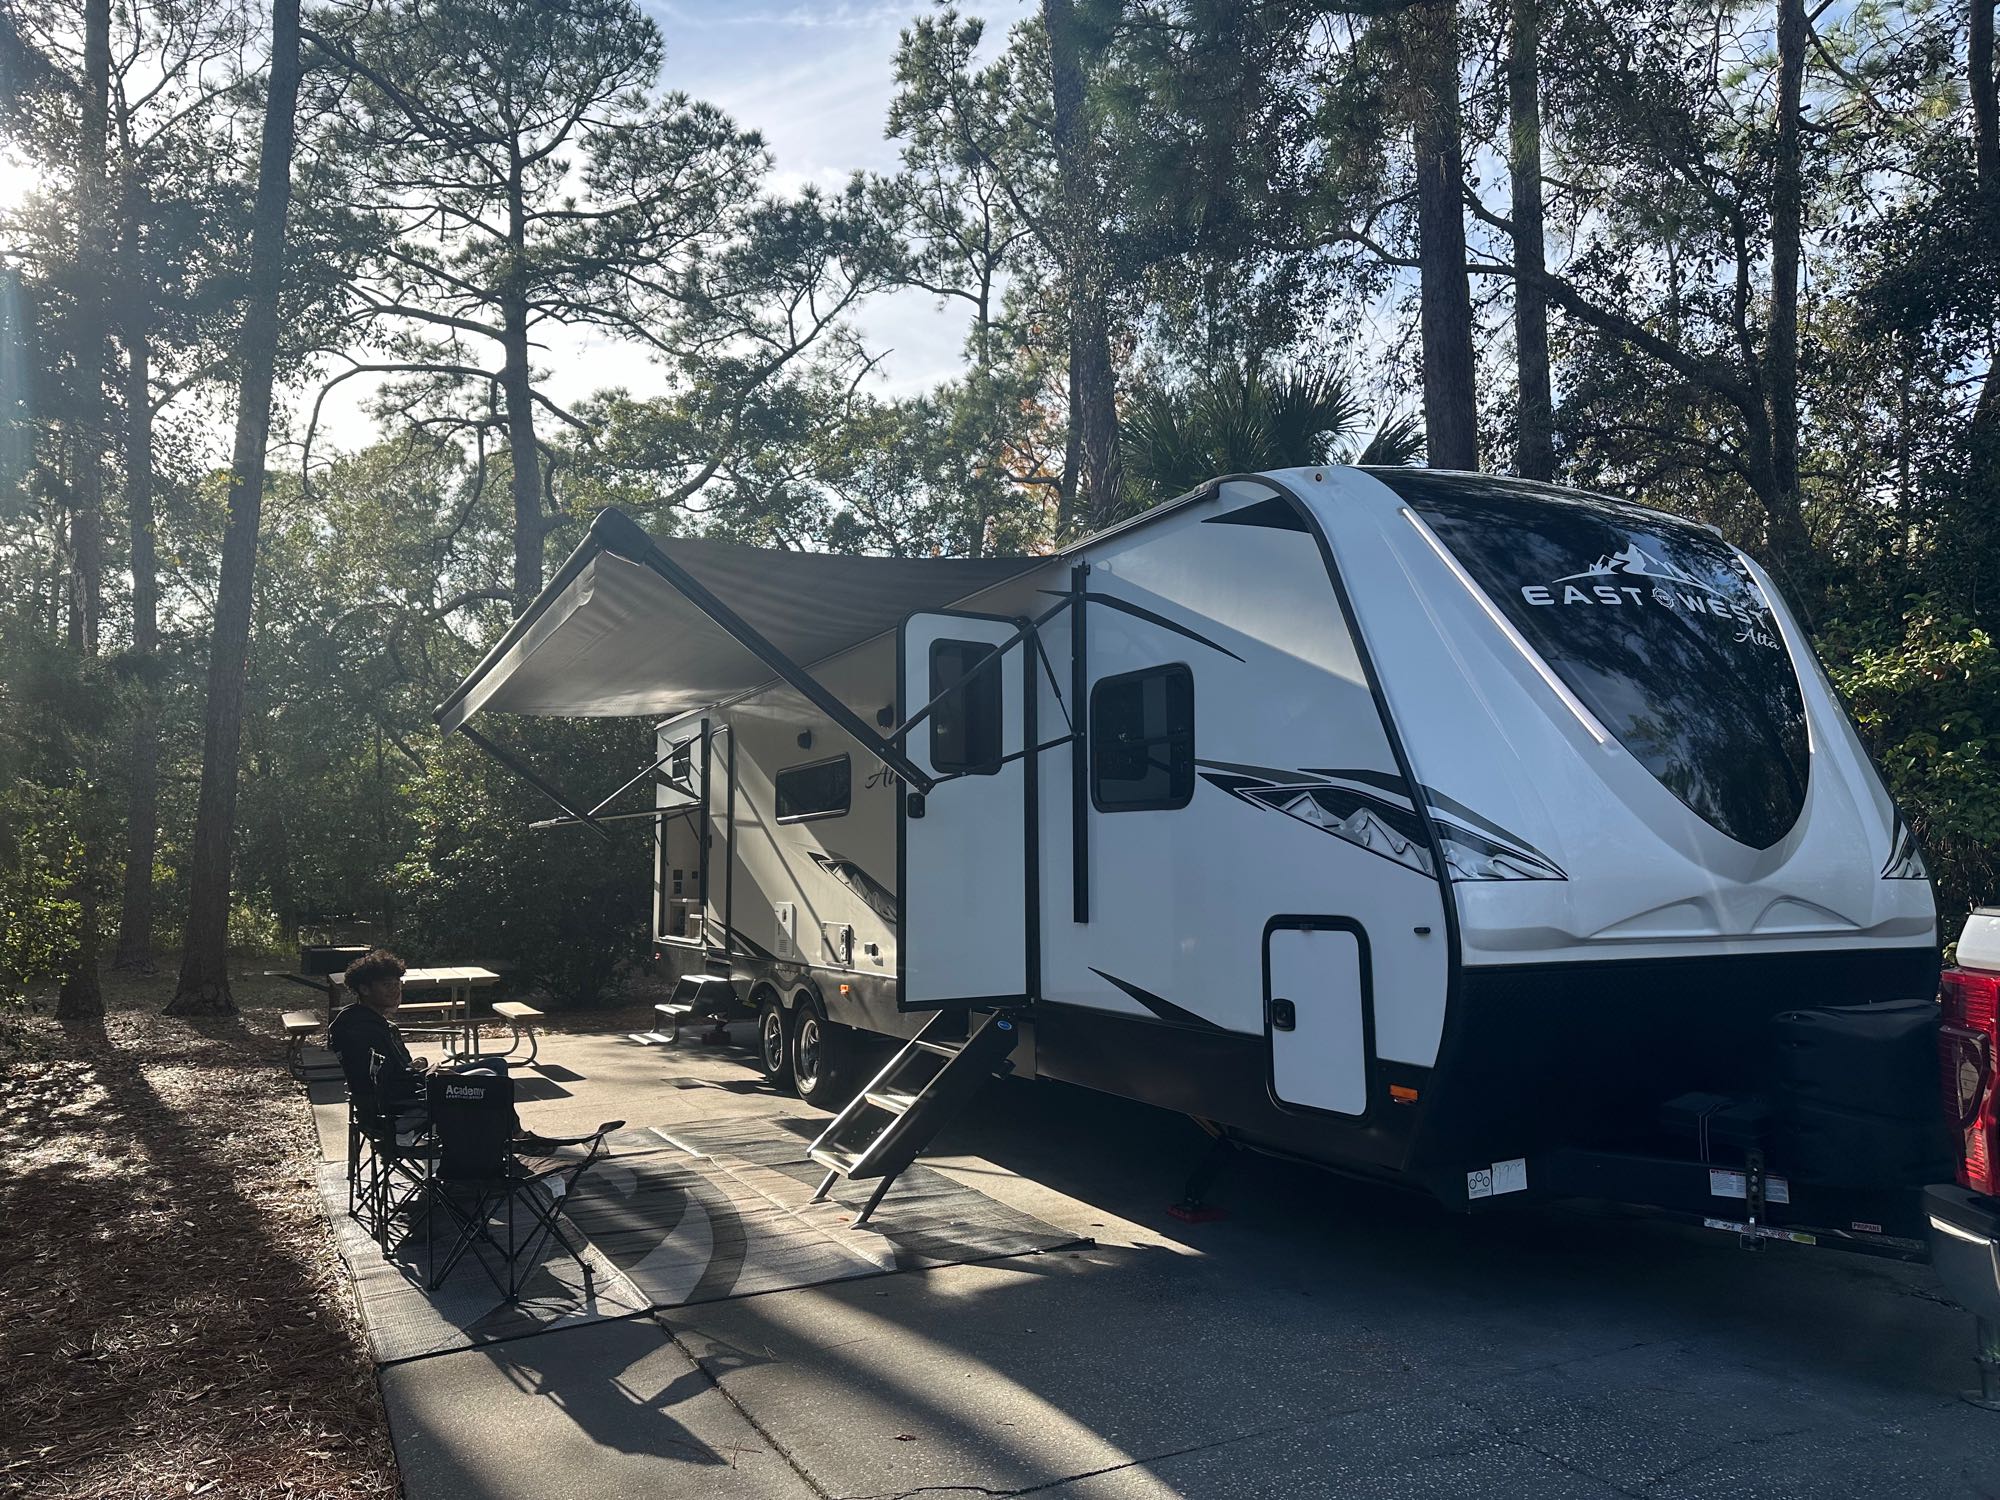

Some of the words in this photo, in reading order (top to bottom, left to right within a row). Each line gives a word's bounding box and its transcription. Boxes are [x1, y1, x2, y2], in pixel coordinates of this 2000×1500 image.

[1521, 585, 1643, 606] EAST
[1675, 592, 1766, 629] WEST
[1733, 628, 1780, 650] Alta
[865, 764, 896, 789] Al
[445, 1084, 486, 1099] Academy
